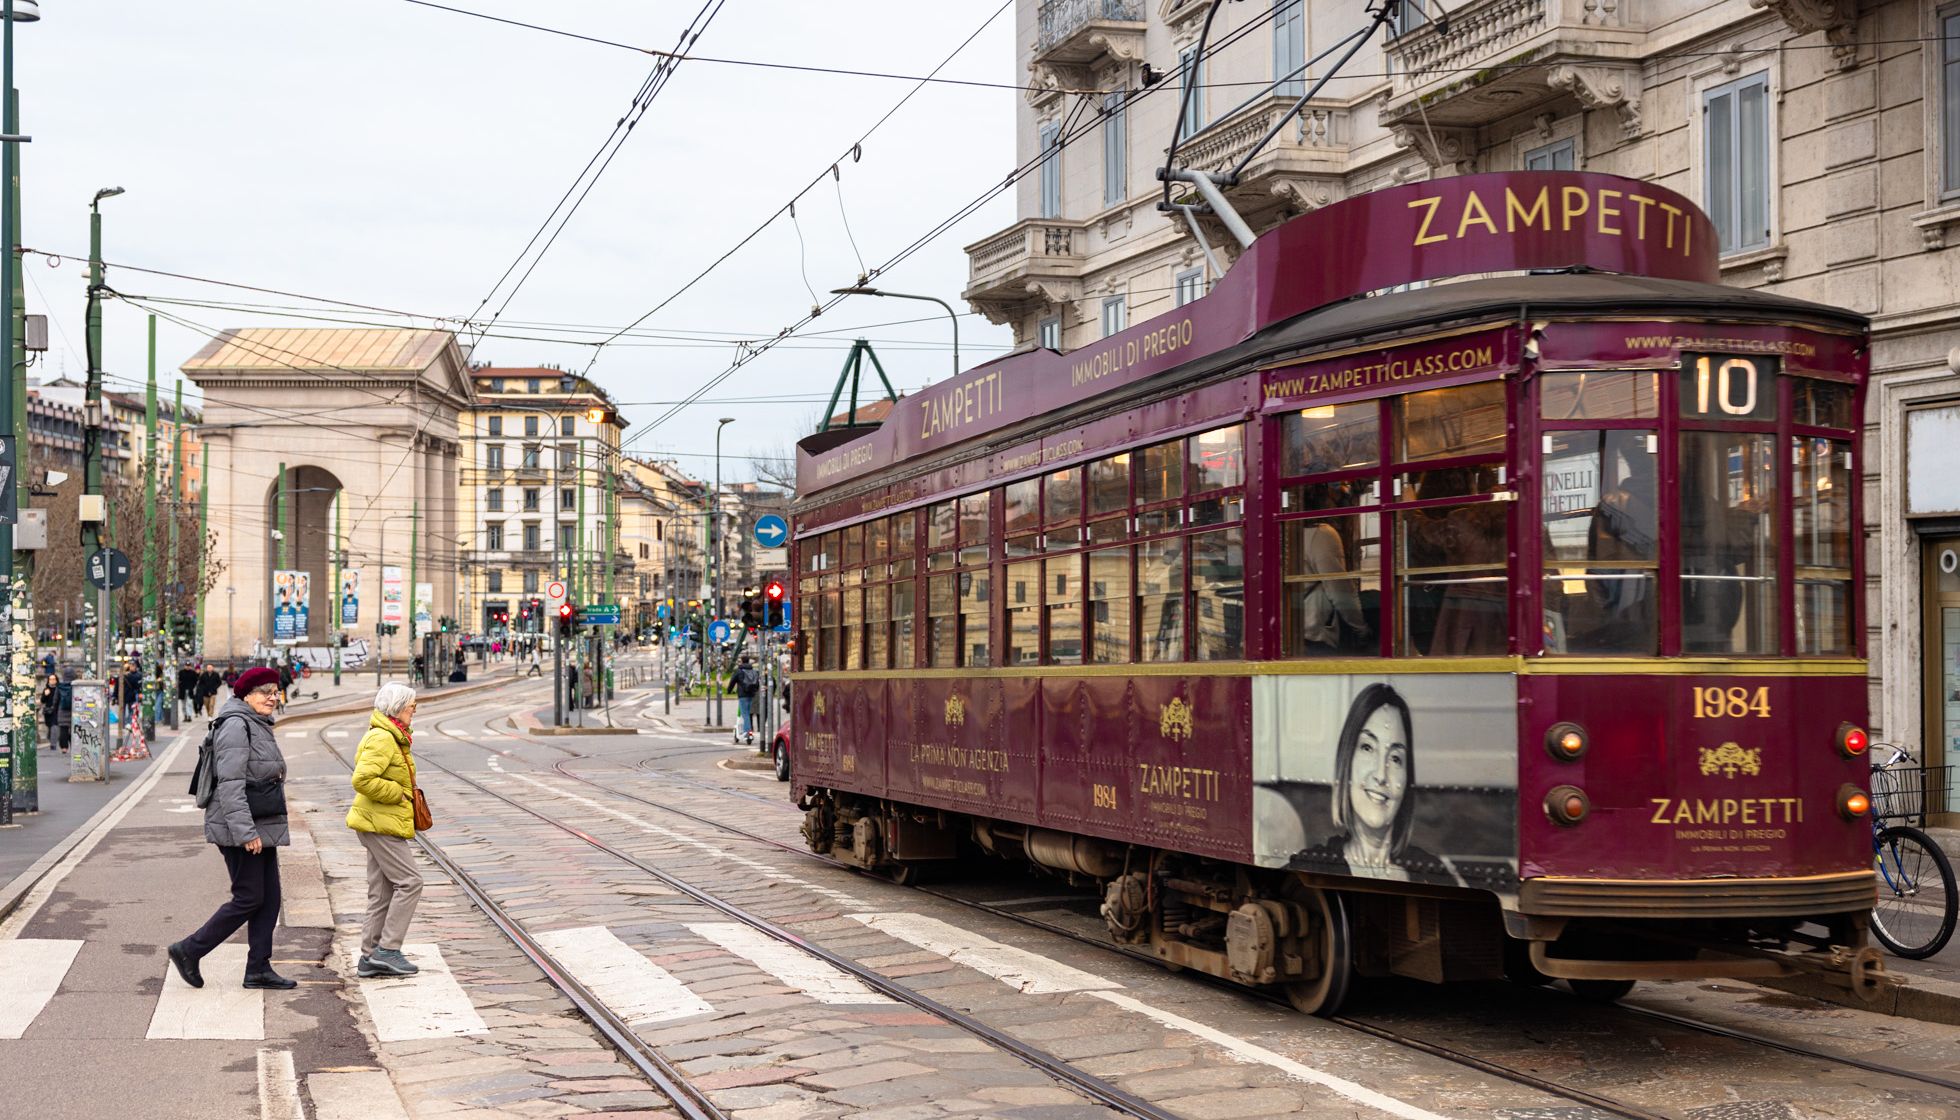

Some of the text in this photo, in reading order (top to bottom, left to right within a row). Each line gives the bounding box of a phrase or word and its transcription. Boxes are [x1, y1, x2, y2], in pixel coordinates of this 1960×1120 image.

[1407, 185, 1692, 257] ZAMPETTI
[1071, 319, 1193, 387] IMMOBILI DI PREGIO
[1263, 346, 1492, 399] WWW.ZAMPETTICLASS.COM
[921, 370, 1002, 440] ZAMPETTI
[1696, 356, 1758, 415] 10
[1693, 686, 1771, 719] 1984
[910, 743, 1009, 773] LA PRIMA NON AGENZIA
[1093, 783, 1117, 810] 1984
[1140, 763, 1219, 802] ZAMPETTI
[1650, 797, 1803, 824] ZAMPETTI
[1675, 829, 1787, 840] IMMOBILI DI PREGIO
